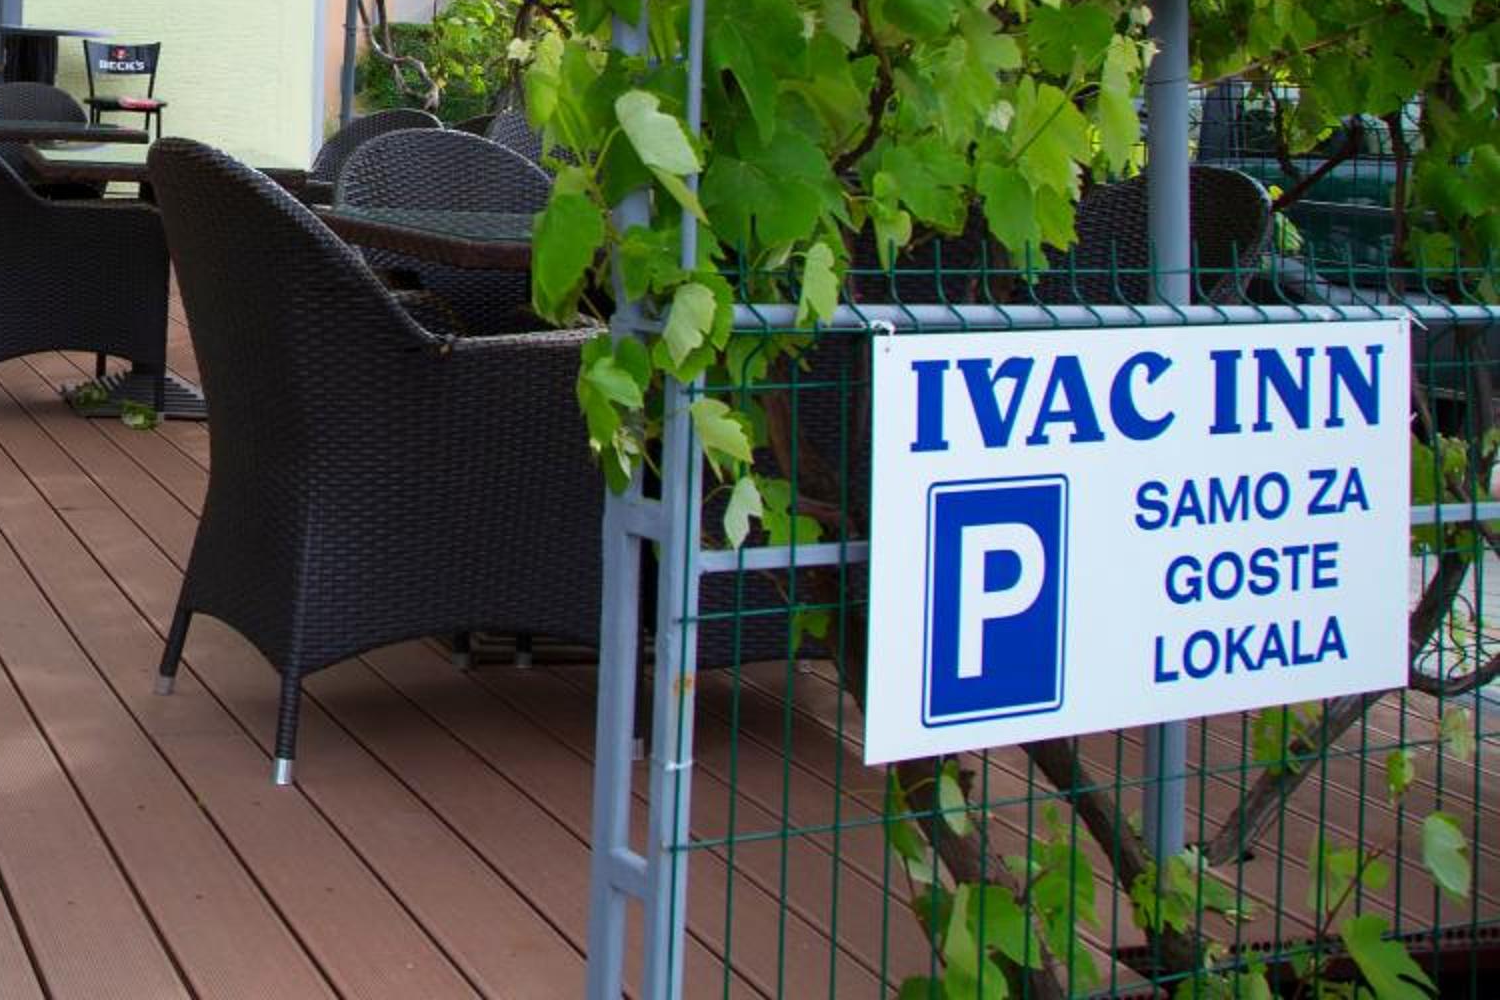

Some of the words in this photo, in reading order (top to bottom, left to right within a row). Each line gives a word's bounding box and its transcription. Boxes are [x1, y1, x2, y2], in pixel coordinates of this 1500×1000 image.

[910, 350, 1176, 453] IVAC
[1209, 344, 1384, 435] INN
[1134, 471, 1292, 531] SAMO
[1307, 466, 1370, 517] ZA
[957, 521, 1046, 680] P
[1164, 541, 1339, 605] GOSTE
[1153, 615, 1348, 684] LOKALA
